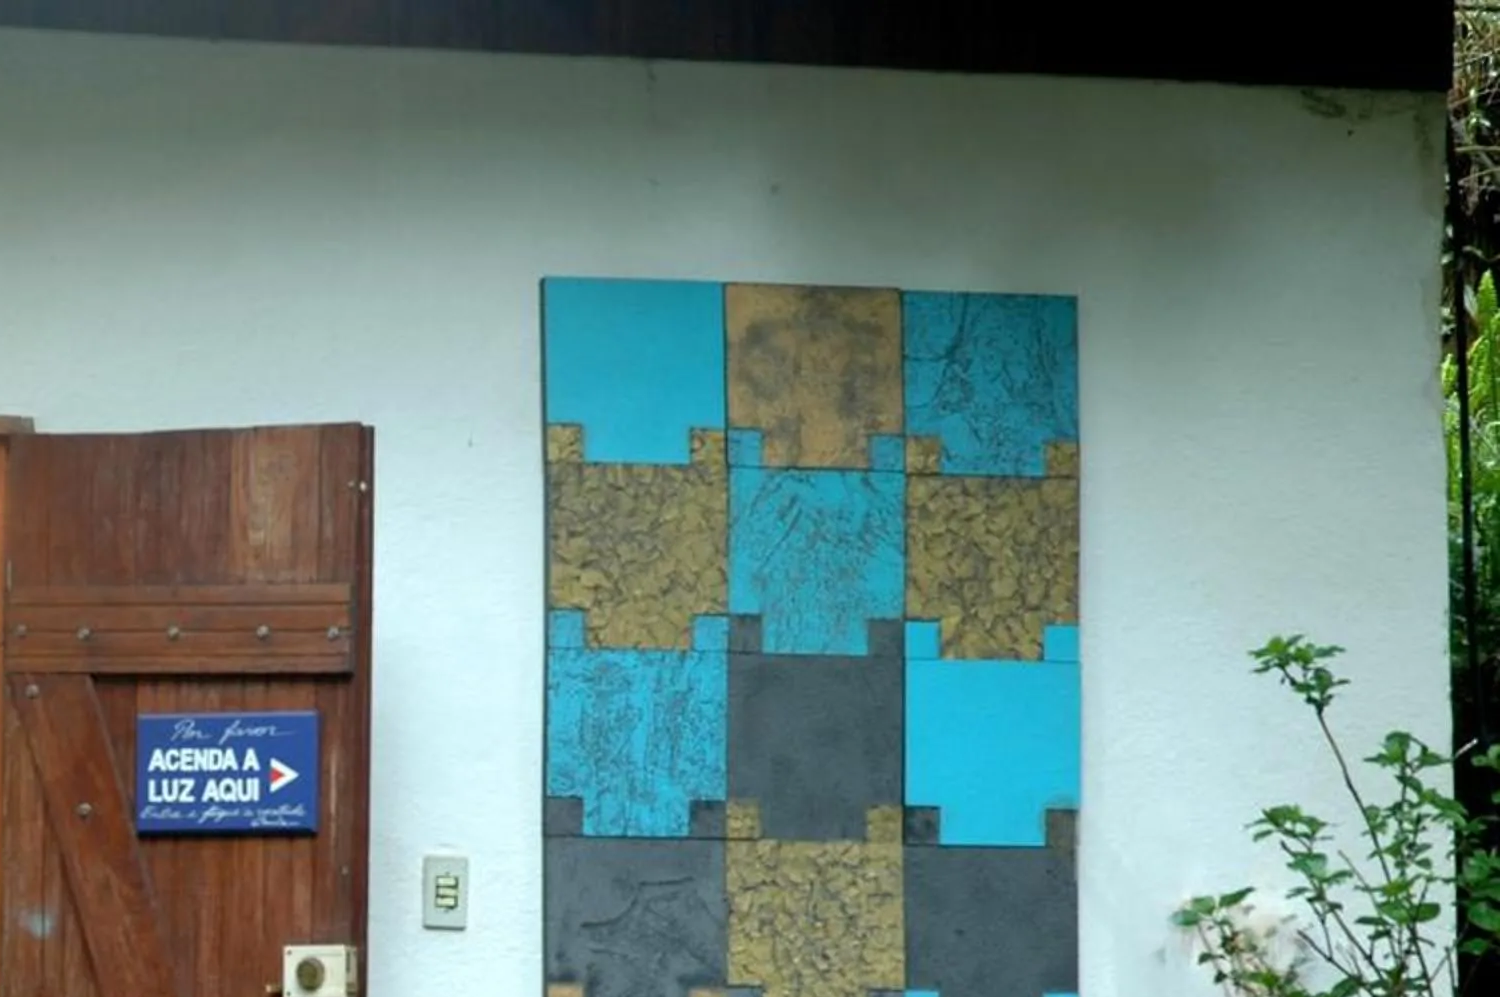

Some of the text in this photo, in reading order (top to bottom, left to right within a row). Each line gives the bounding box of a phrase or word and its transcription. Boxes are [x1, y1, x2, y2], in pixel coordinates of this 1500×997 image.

[148, 748, 260, 772] ACENDA A
[148, 778, 260, 803] LUZ AQUI
